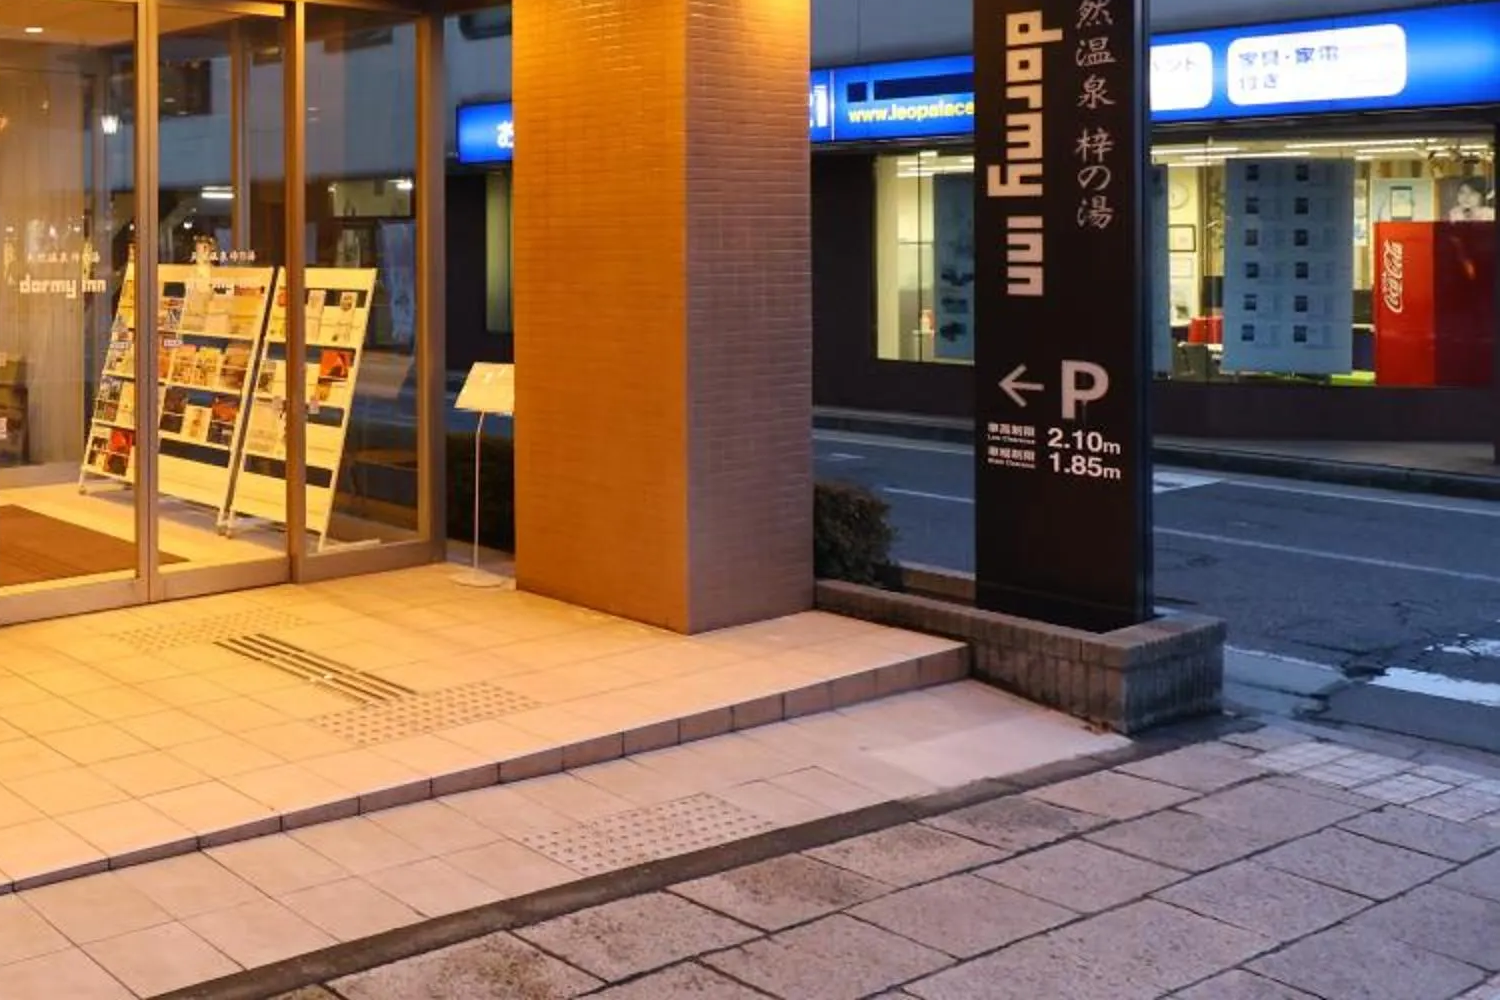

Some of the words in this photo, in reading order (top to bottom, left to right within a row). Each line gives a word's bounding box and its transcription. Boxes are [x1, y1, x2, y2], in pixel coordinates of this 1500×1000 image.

[987, 10, 1063, 197] dormy
[1006, 216, 1043, 296] inn
[19, 274, 77, 298] dormy
[1061, 360, 1109, 419] P
[1047, 427, 1121, 455] 2.10m
[1049, 452, 1121, 479] 1.85m
